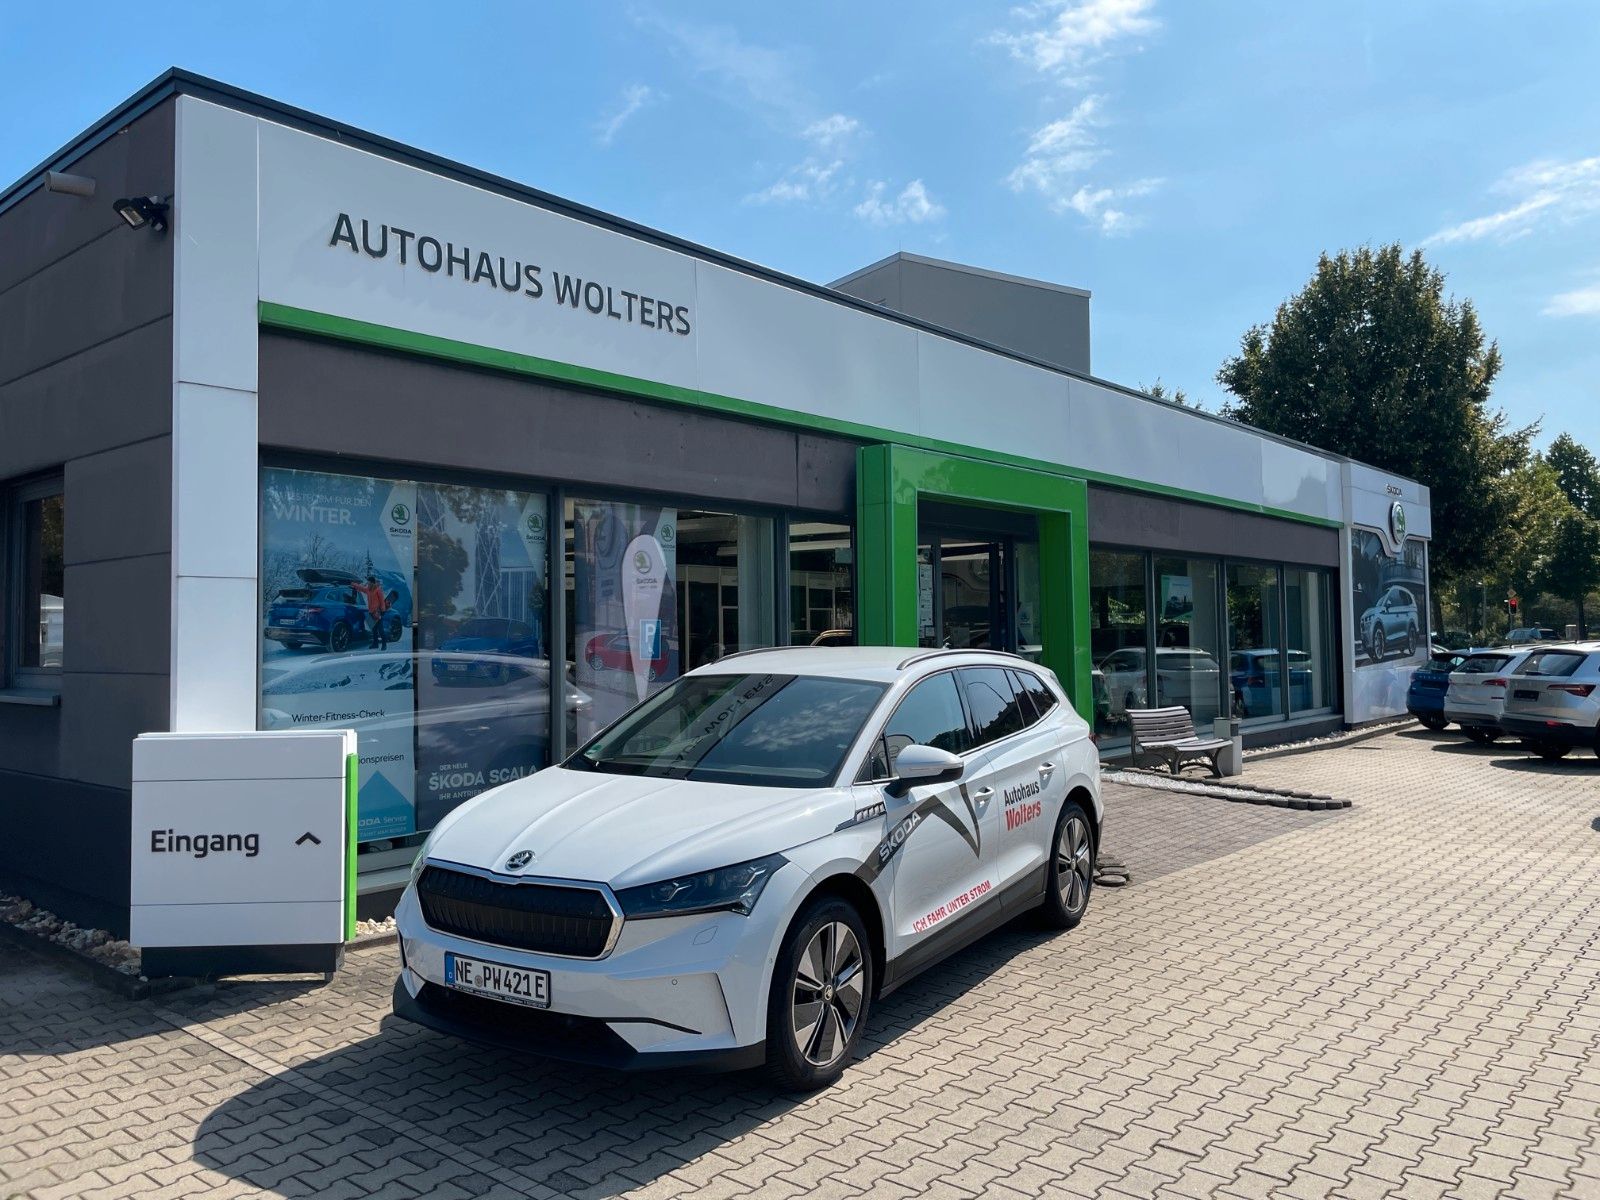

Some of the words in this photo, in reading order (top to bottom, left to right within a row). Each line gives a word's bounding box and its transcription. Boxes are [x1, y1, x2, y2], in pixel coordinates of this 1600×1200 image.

[329, 212, 544, 299] AUTOHAUS
[552, 271, 691, 337] WOLTERS
[273, 504, 357, 525] WINTER.
[645, 623, 656, 643] P
[291, 709, 385, 723] Winter-Fitness-Check
[428, 770, 486, 791] ŠKODA
[1003, 780, 1040, 807] Autohaus
[1005, 801, 1042, 832] Wolters
[150, 828, 260, 859] Eingang
[879, 811, 922, 861] ŠKODA
[912, 919, 927, 933] ICH
[927, 907, 948, 929] FAHR
[947, 892, 970, 914] UNTER
[970, 880, 992, 901] STROM
[455, 959, 473, 985] NE
